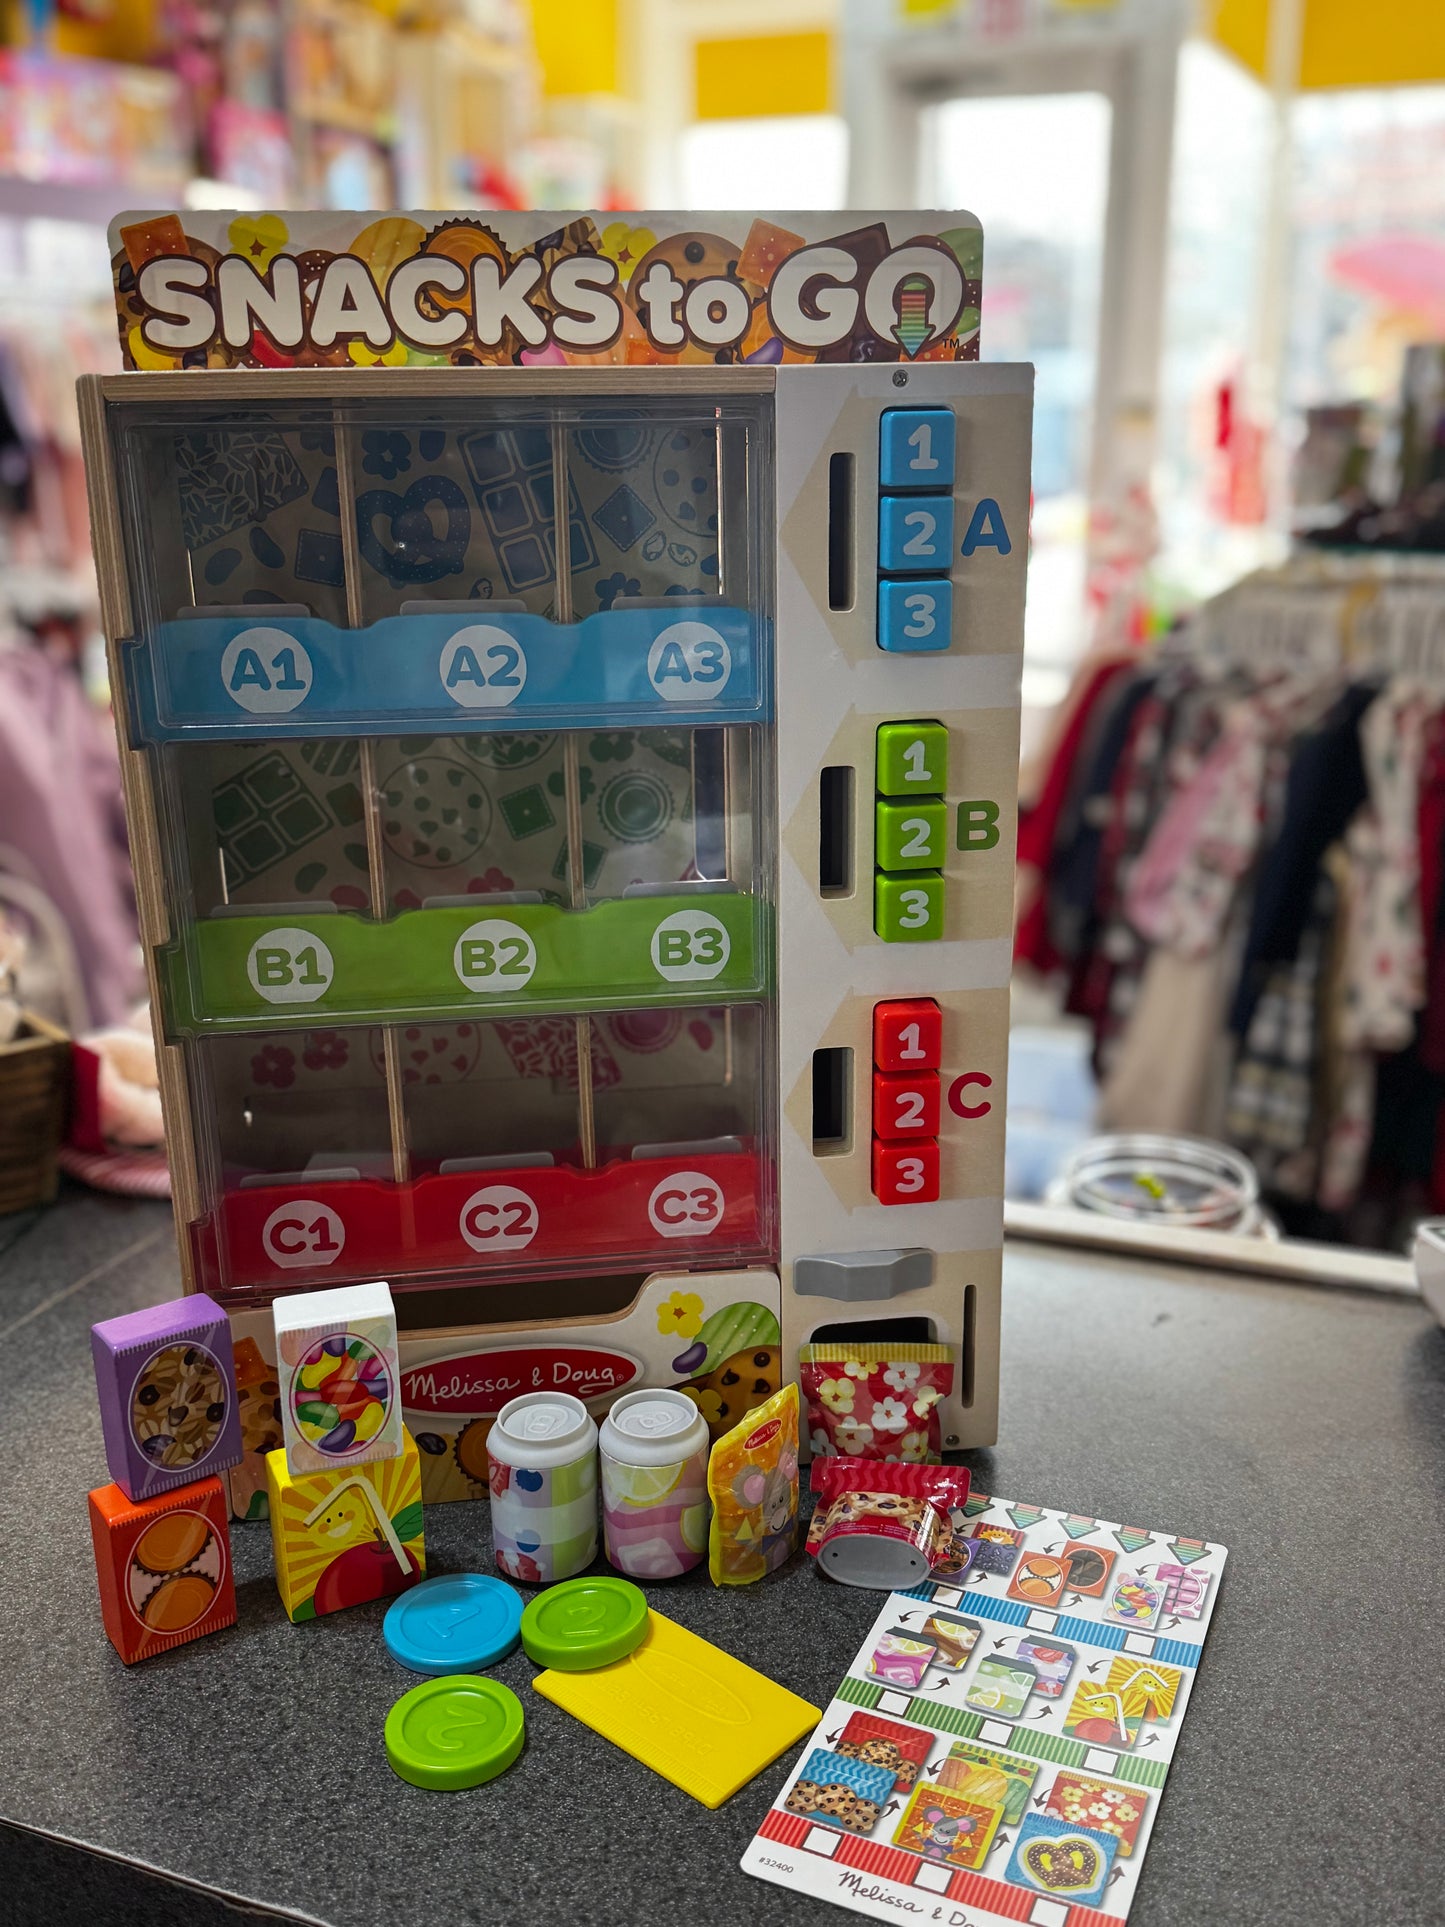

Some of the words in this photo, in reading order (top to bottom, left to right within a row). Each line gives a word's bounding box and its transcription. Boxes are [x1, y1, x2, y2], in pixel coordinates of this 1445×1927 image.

[140, 253, 620, 353] SNACKS
[640, 270, 749, 346] to
[771, 245, 964, 347] GO
[908, 424, 939, 470] 1
[903, 511, 936, 556] 2
[960, 498, 1012, 557] A
[903, 594, 936, 638] 3
[229, 647, 306, 691] A1
[446, 645, 521, 687] A2
[654, 641, 725, 683] A3
[902, 740, 932, 781] 1
[900, 818, 931, 857] 2
[956, 800, 1000, 851] B
[899, 890, 930, 928] 3
[460, 938, 531, 977] B2
[658, 926, 724, 967] B3
[255, 948, 328, 987] B1
[898, 1023, 926, 1059] 1
[895, 1092, 925, 1128] 2
[948, 1072, 993, 1119] C
[895, 1158, 925, 1193] 3
[465, 1204, 533, 1239] C2
[654, 1187, 719, 1221] C3
[269, 1216, 340, 1255] C1
[405, 1373, 521, 1405] Melissa
[532, 1367, 544, 1386] &
[553, 1362, 615, 1394] Doug
[758, 1855, 795, 1874] #32400
[837, 1870, 924, 1914] Melissa
[931, 1906, 943, 1920] &
